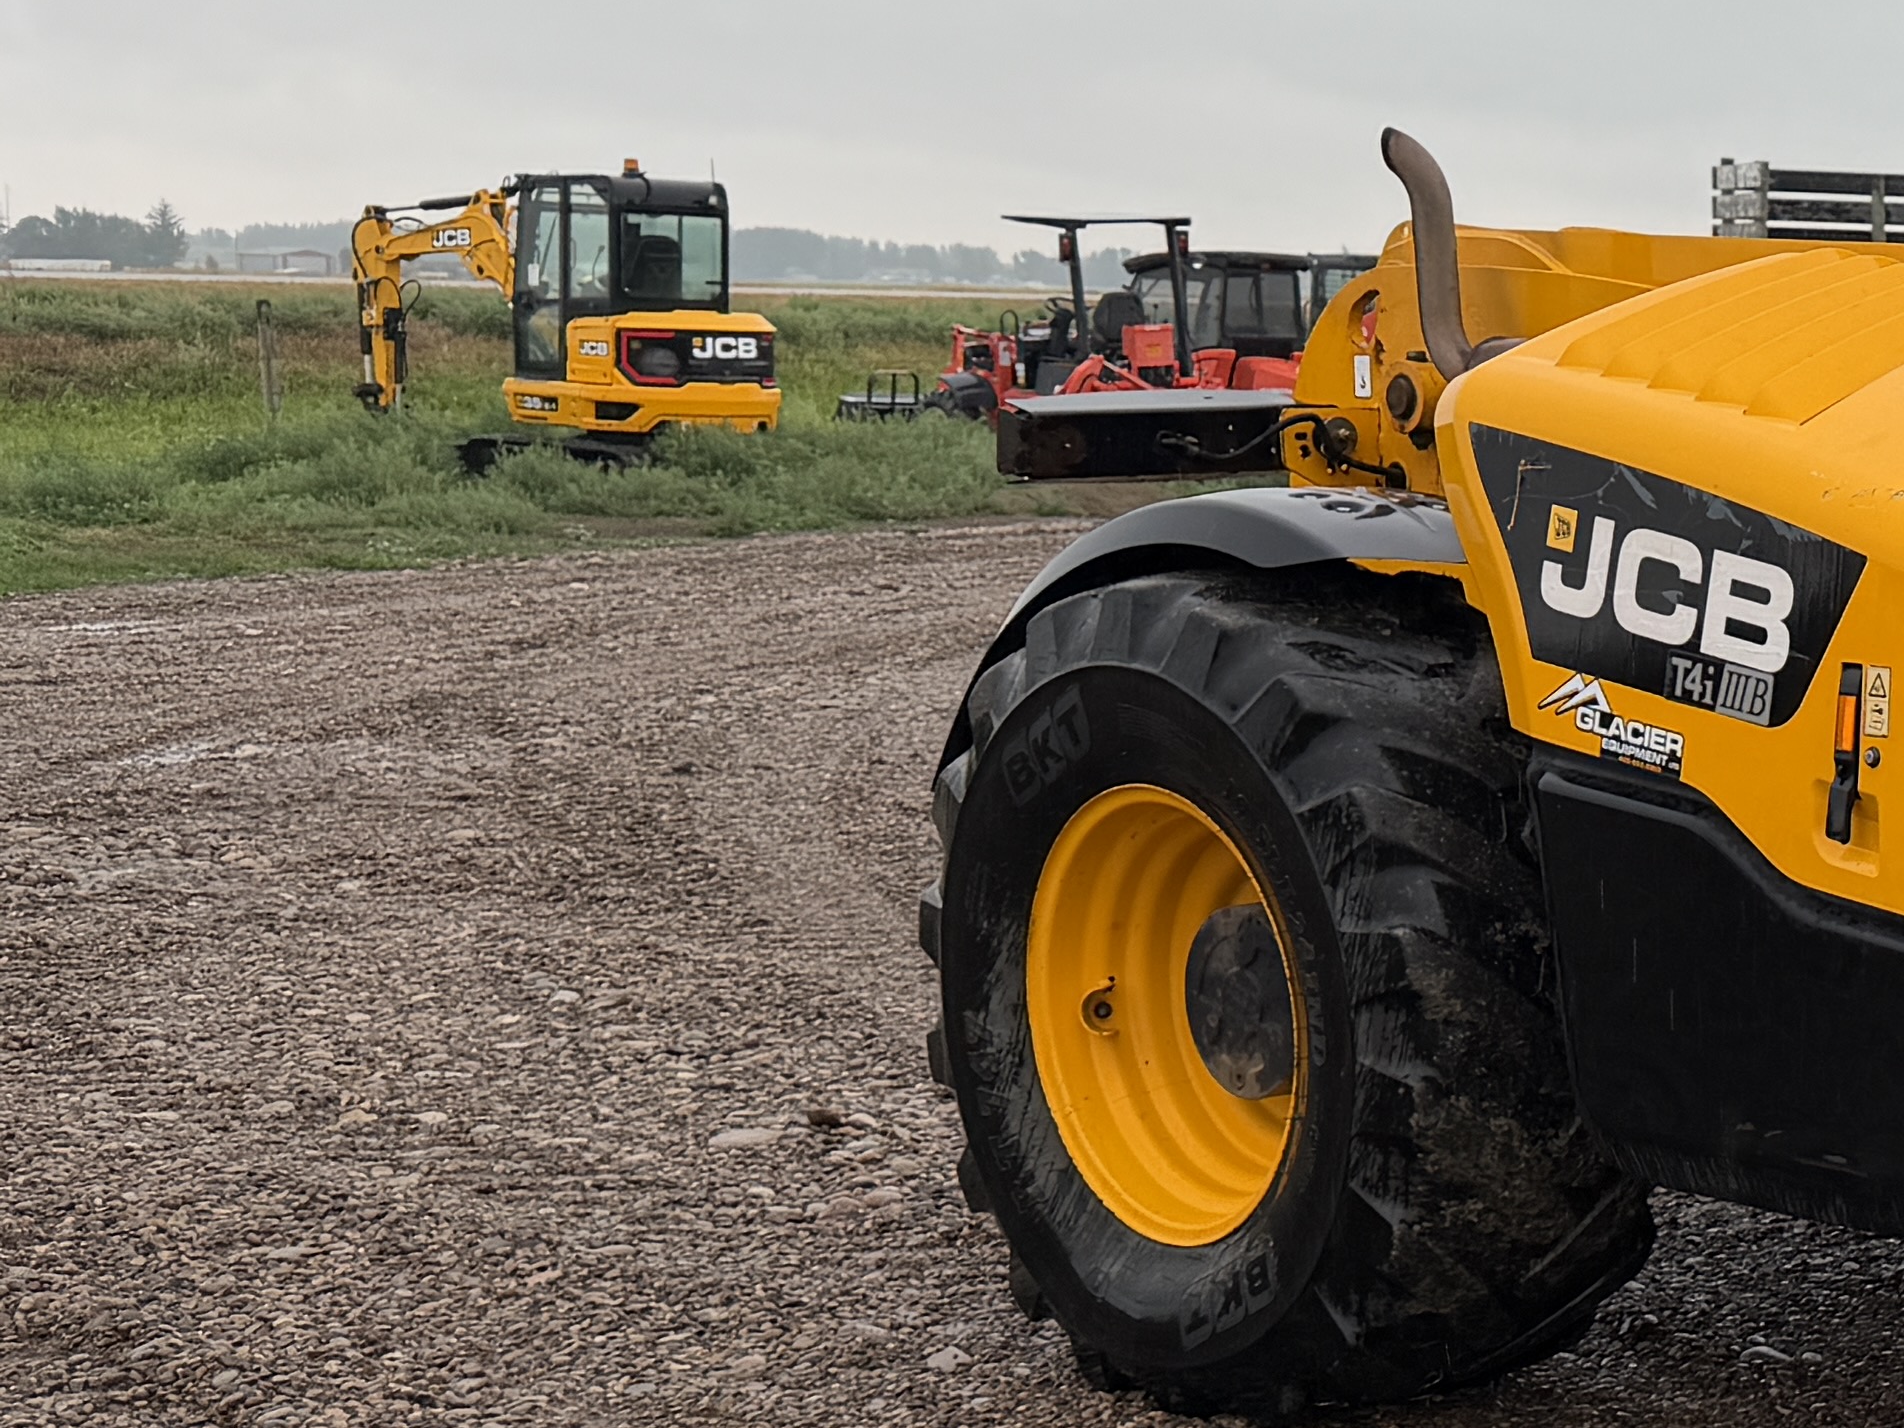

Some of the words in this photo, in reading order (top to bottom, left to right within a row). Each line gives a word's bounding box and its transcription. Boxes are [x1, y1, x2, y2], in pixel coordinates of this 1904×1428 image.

[433, 228, 471, 248] JCB
[580, 341, 609, 356] JCB
[692, 336, 758, 359] JCB
[1540, 515, 1795, 673] JCB
[1671, 656, 1716, 707] T4i
[1004, 692, 1087, 799] BKT
[1576, 706, 1683, 758] GLACIER
[1602, 737, 1669, 768] EQUIPMENT
[1183, 1250, 1273, 1342] BKT
